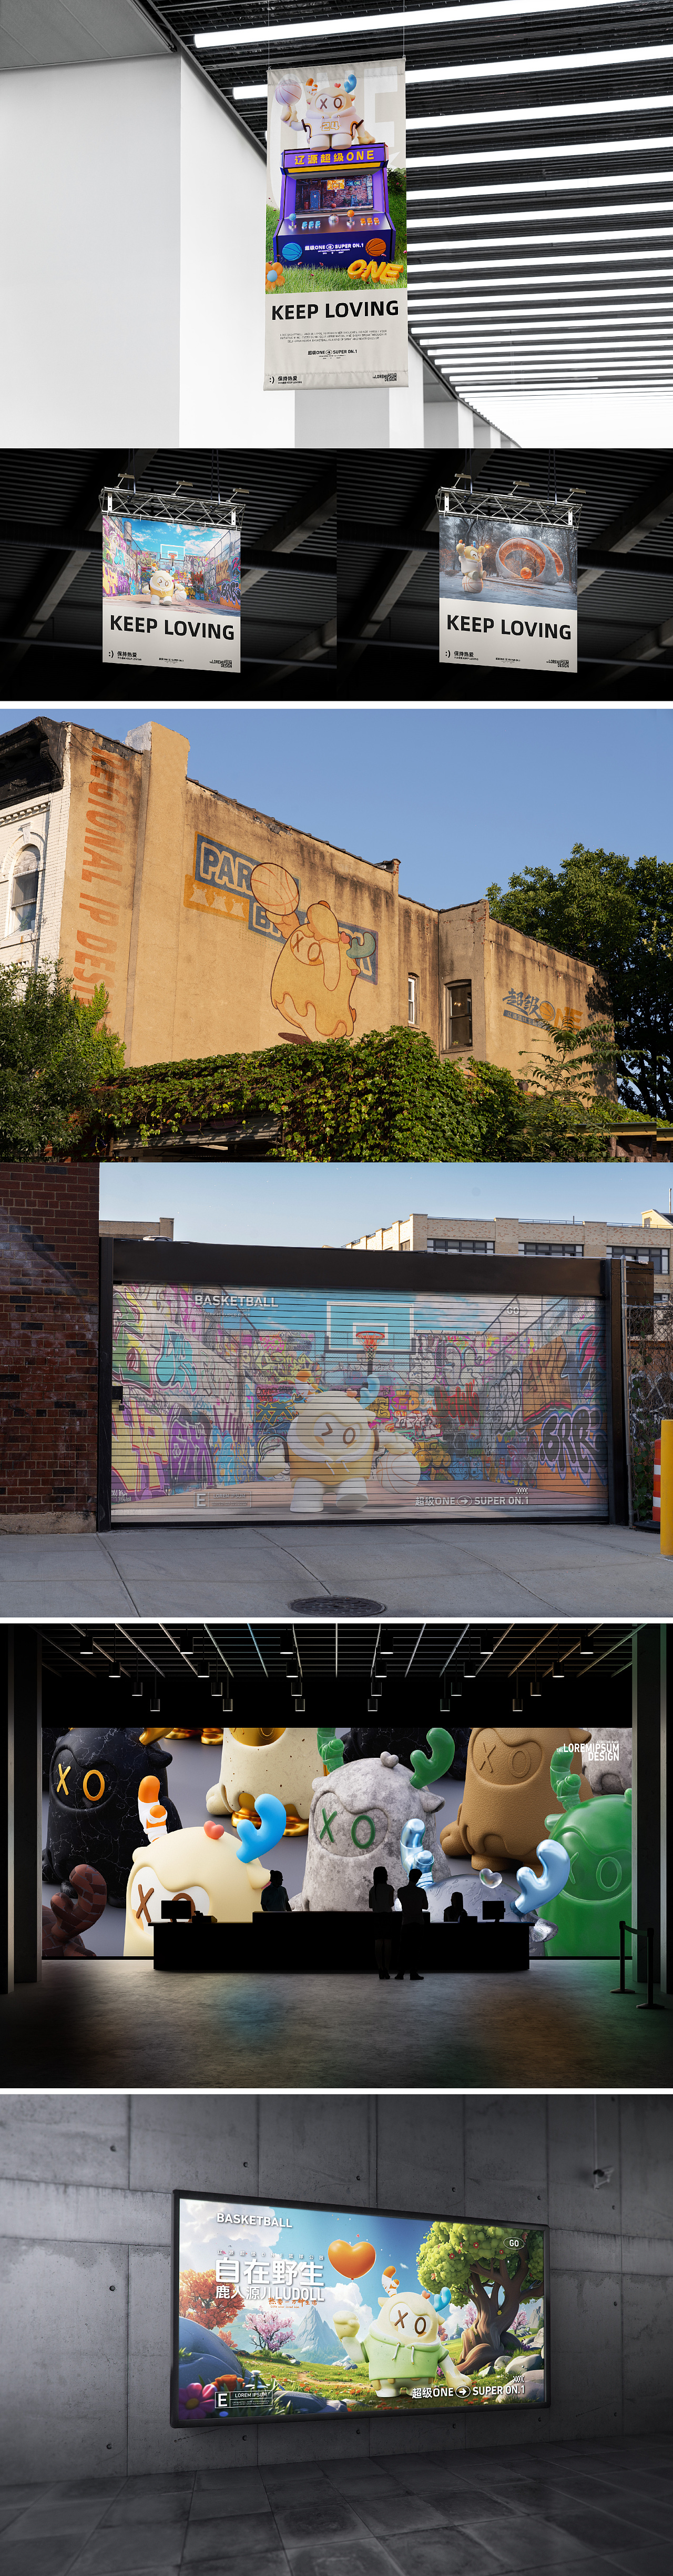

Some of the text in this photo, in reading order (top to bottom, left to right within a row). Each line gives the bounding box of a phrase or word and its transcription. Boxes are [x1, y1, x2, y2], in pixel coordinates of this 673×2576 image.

[321, 121, 340, 132] 24
[294, 150, 374, 165] 辽源超级ONE
[347, 259, 404, 285] ONE
[272, 300, 399, 320] KEEP LOVING
[110, 615, 234, 640] KEEP LOVING
[447, 615, 571, 640] KEEP LOVING
[200, 841, 257, 897] PAR
[72, 746, 131, 1026] REGIONAL IP DESI
[195, 1295, 279, 1307] BASKETBALL
[507, 1306, 519, 1315] GO
[197, 1493, 206, 1507] E
[474, 1497, 506, 1505] SUPER
[508, 1497, 528, 1505] ON.1
[589, 1752, 619, 1761] DESIGN
[217, 2212, 293, 2228] BASKETBALL
[216, 2257, 324, 2286] 自在野生
[412, 2385, 525, 2399] 超级ONE SUPER ON.1
[218, 2393, 227, 2407] E
